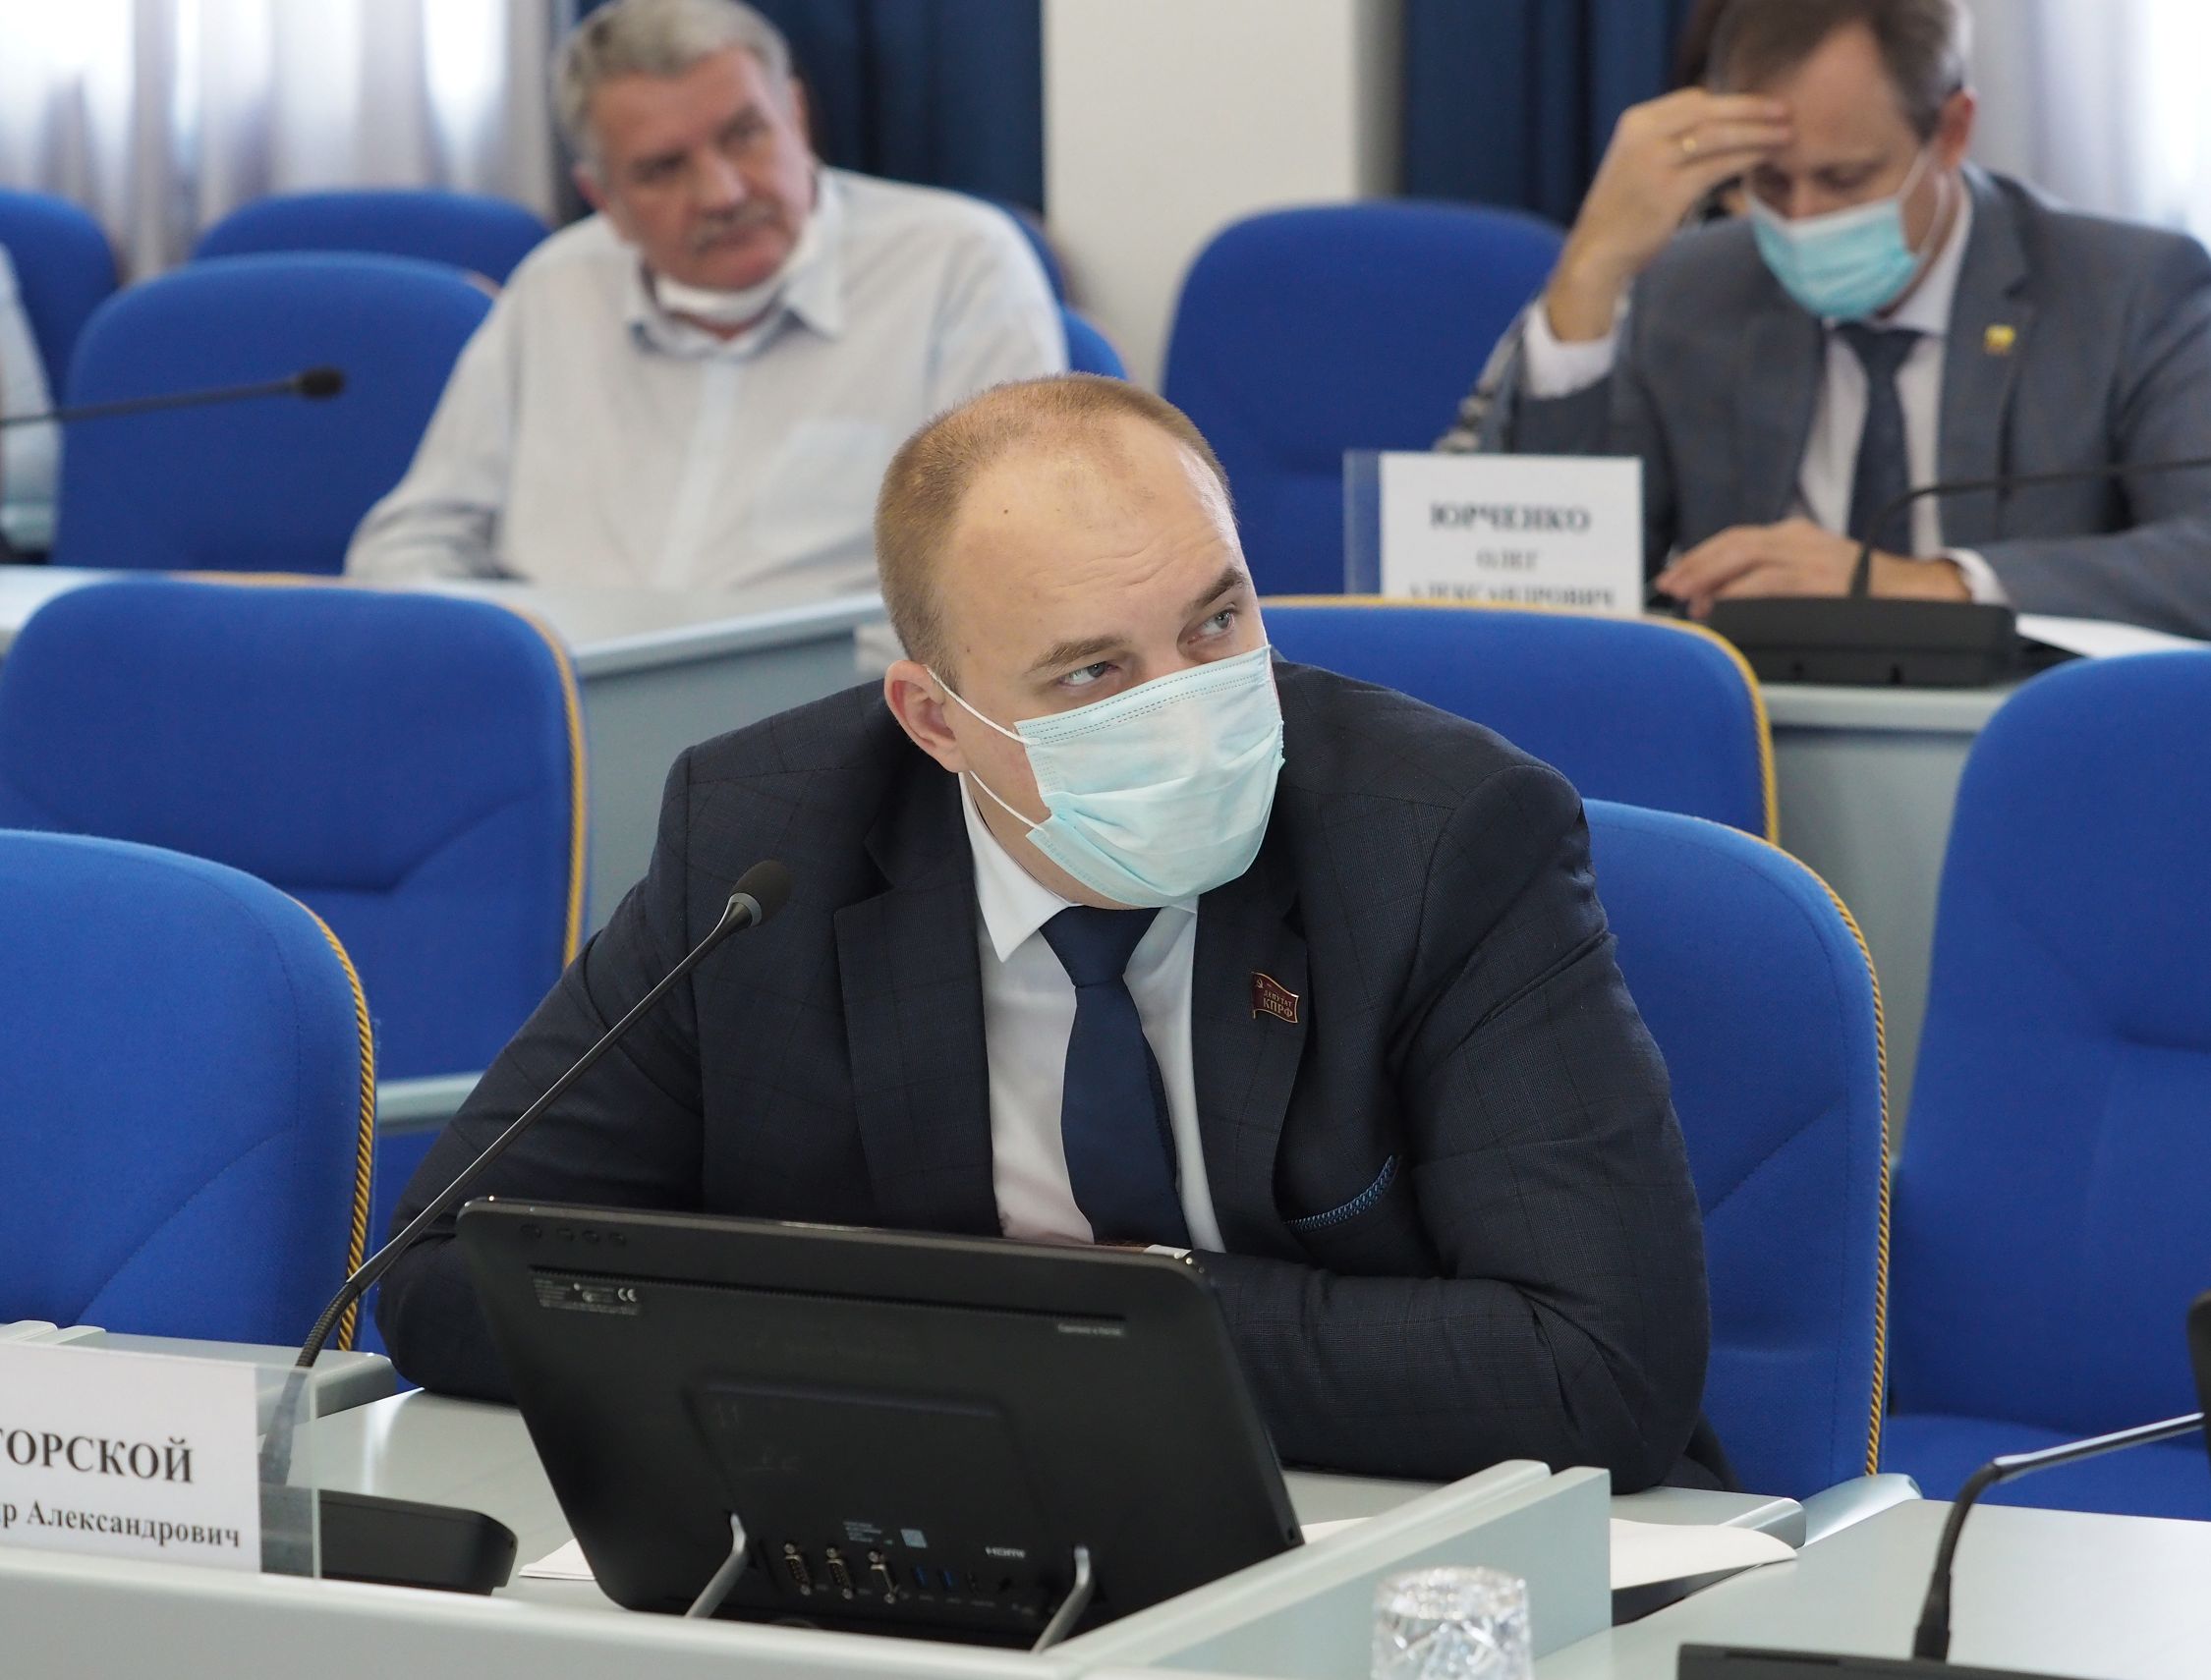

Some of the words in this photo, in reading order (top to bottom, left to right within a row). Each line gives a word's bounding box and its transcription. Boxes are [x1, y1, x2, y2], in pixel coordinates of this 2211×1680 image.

[1430, 503, 1591, 532] ЮРЧЕНКО
[1263, 997, 1293, 1018] КПРФ
[0, 1428, 194, 1483] ОРСКОЙ
[27, 1500, 240, 1547] Александрович
